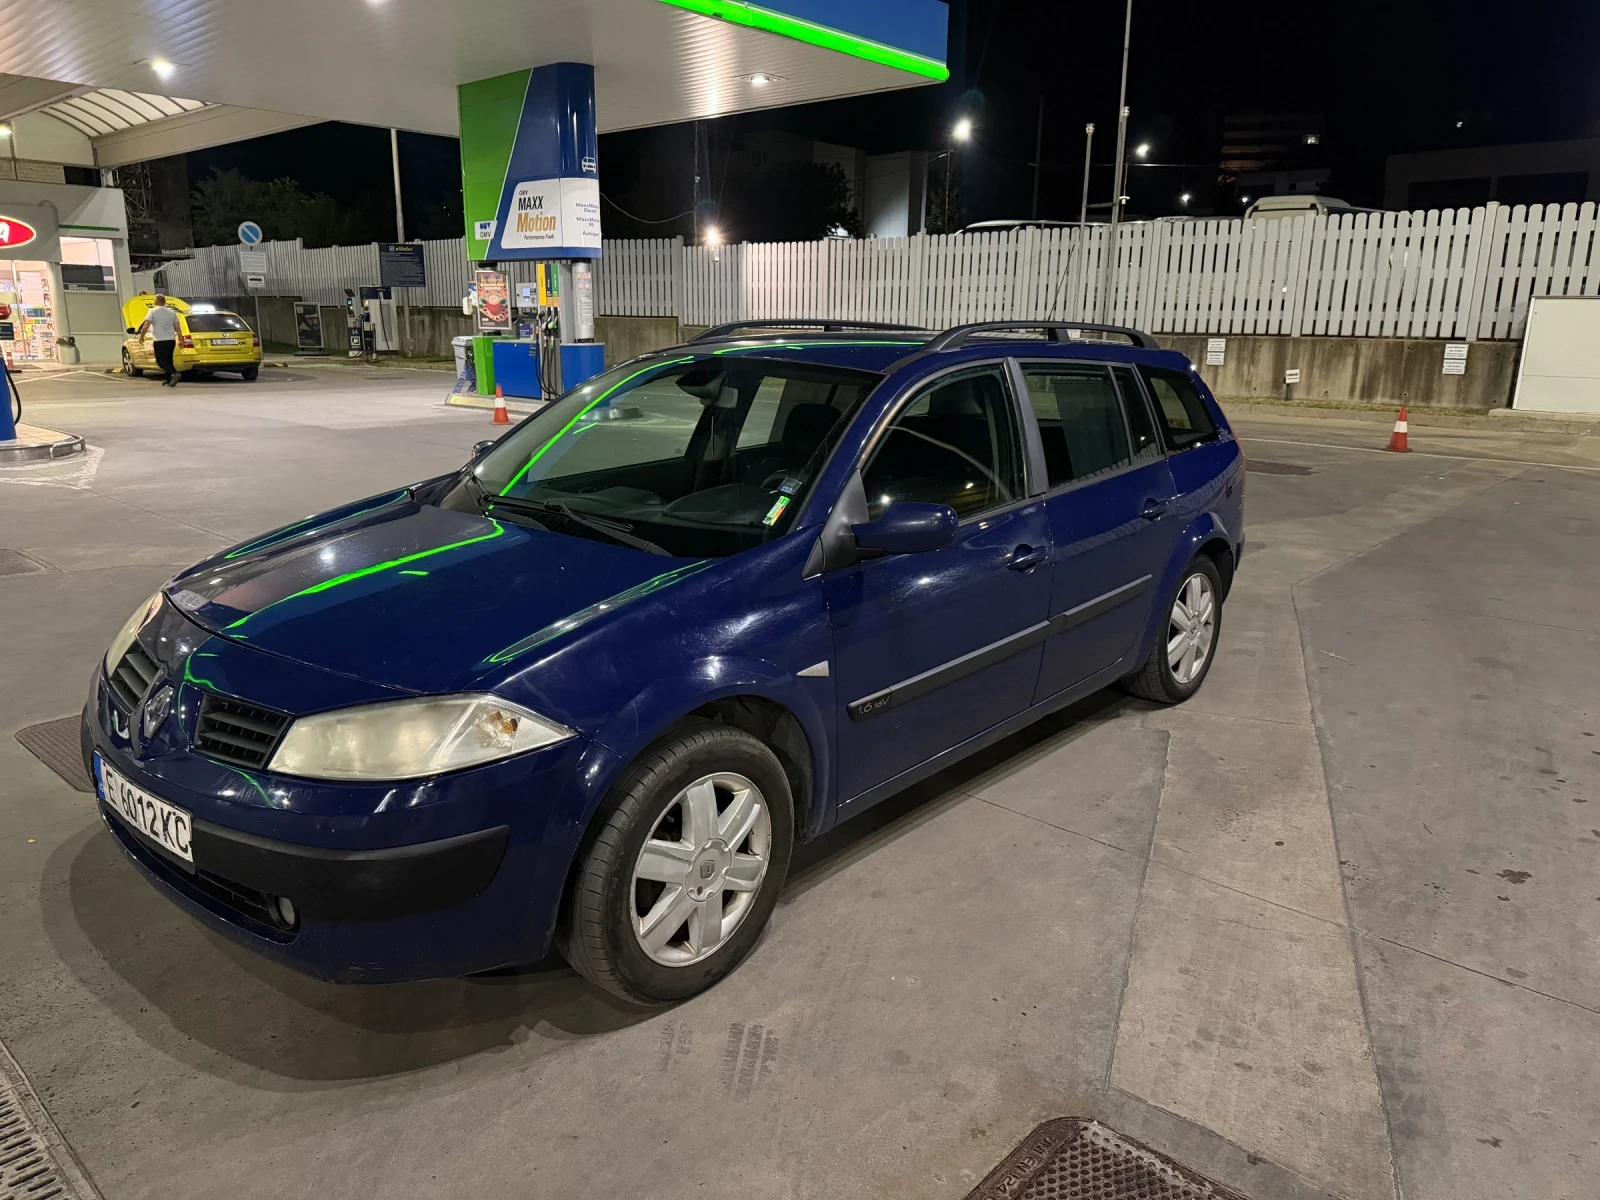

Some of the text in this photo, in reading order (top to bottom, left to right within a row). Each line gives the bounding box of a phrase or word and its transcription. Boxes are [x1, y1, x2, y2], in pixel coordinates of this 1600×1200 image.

[518, 195, 544, 211] MAXX
[516, 211, 557, 233] Motion
[479, 230, 492, 239] OMV
[1014, 1155, 1037, 1174] EN
